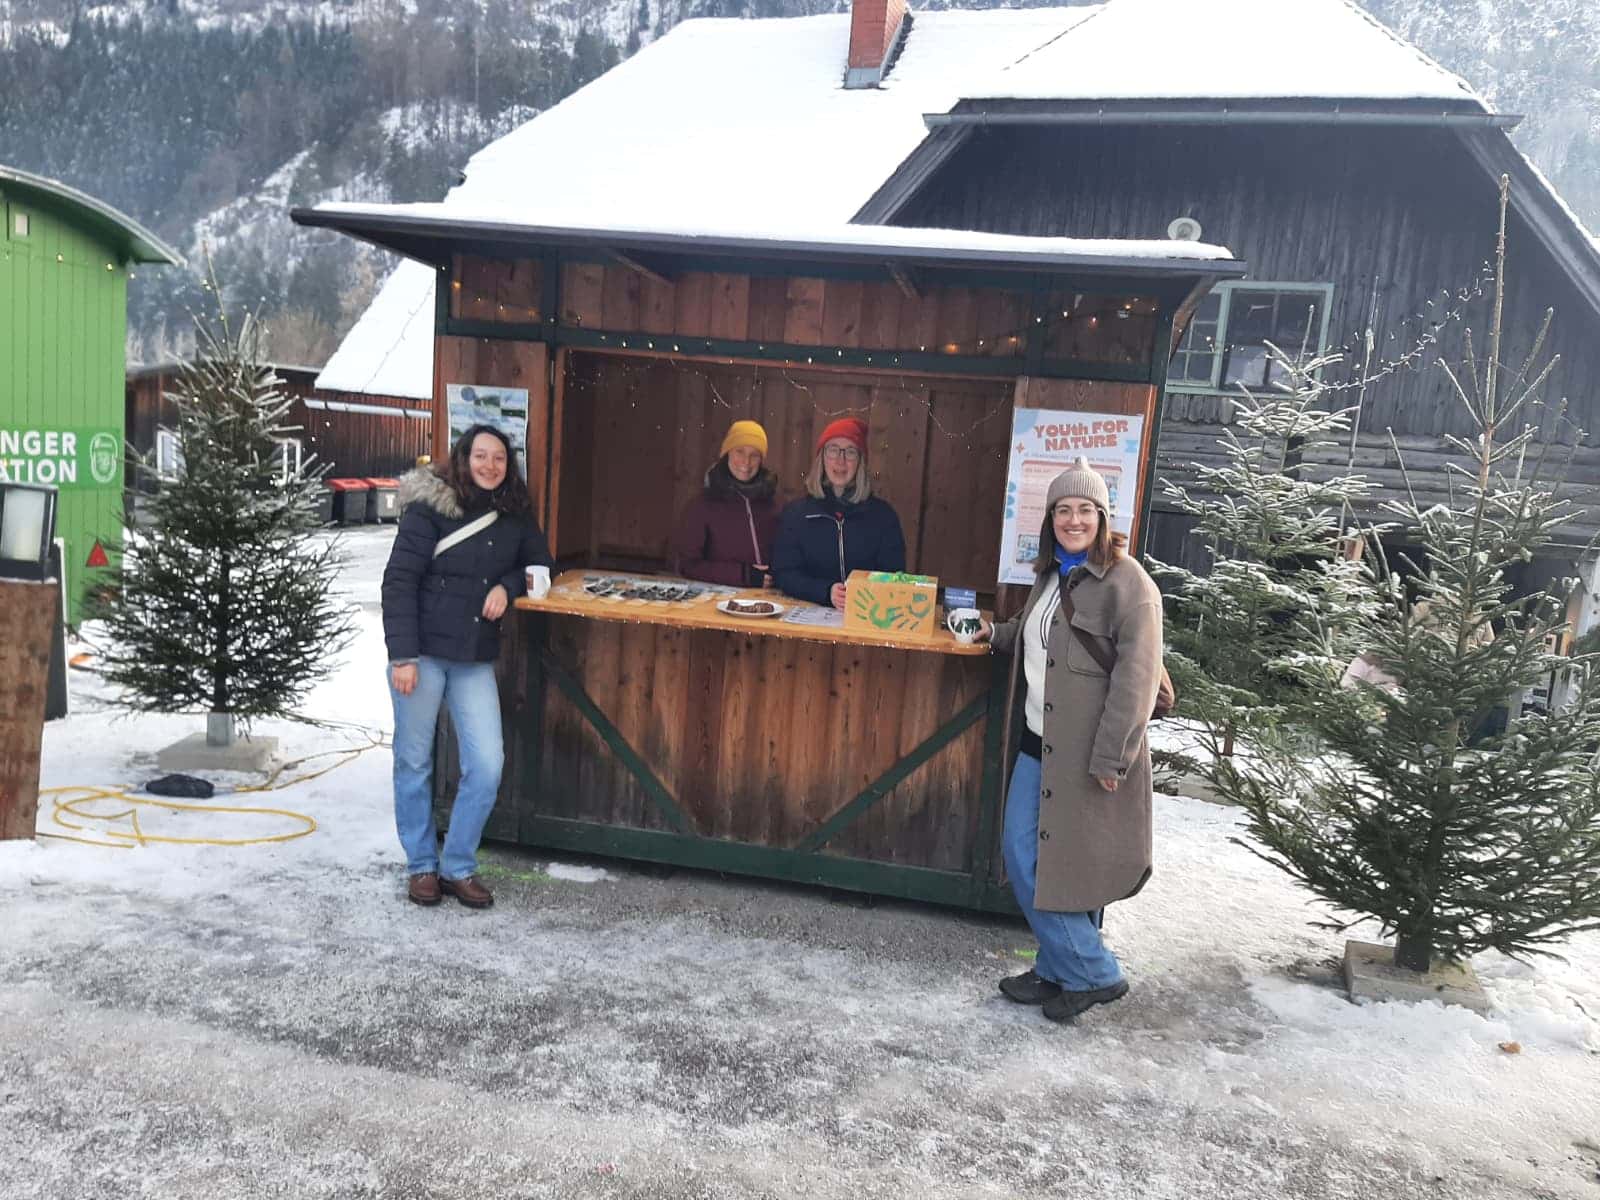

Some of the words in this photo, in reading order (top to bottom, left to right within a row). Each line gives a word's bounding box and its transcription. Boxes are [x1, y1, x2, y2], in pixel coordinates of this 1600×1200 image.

[1092, 420, 1128, 434] FOR
[0, 431, 77, 456] NGER
[1045, 434, 1117, 451] NATURE
